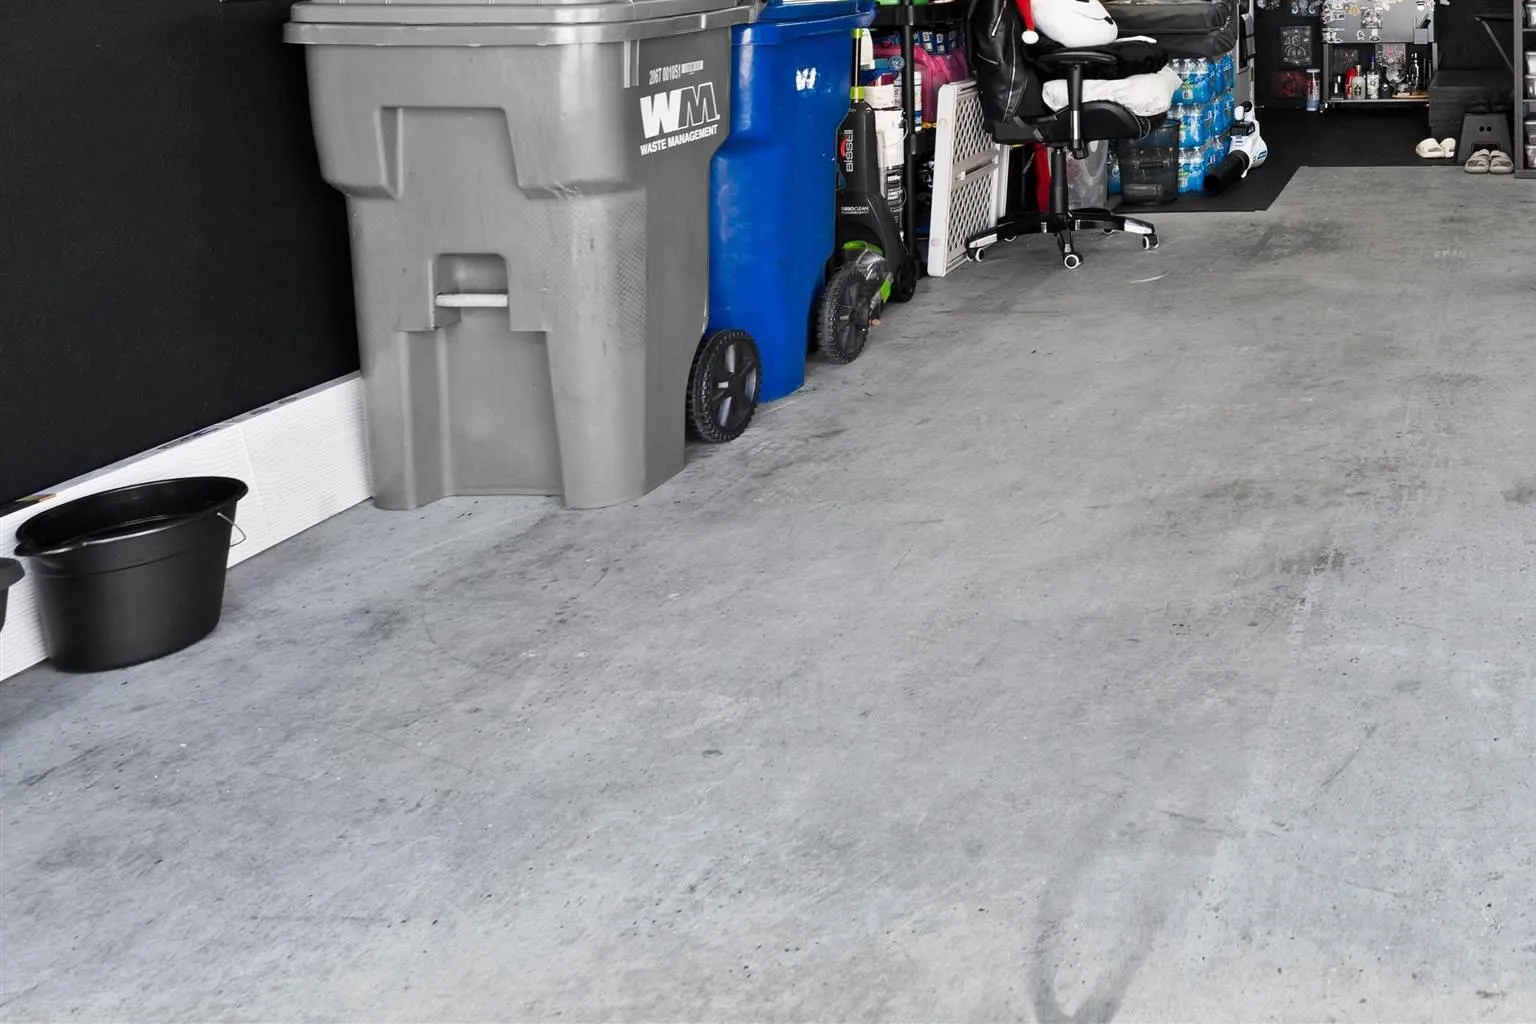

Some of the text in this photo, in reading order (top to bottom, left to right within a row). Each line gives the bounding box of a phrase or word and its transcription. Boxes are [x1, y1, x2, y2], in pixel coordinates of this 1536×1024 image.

[639, 82, 721, 139] WM
[639, 124, 718, 156] WASTE MANAGEMENT
